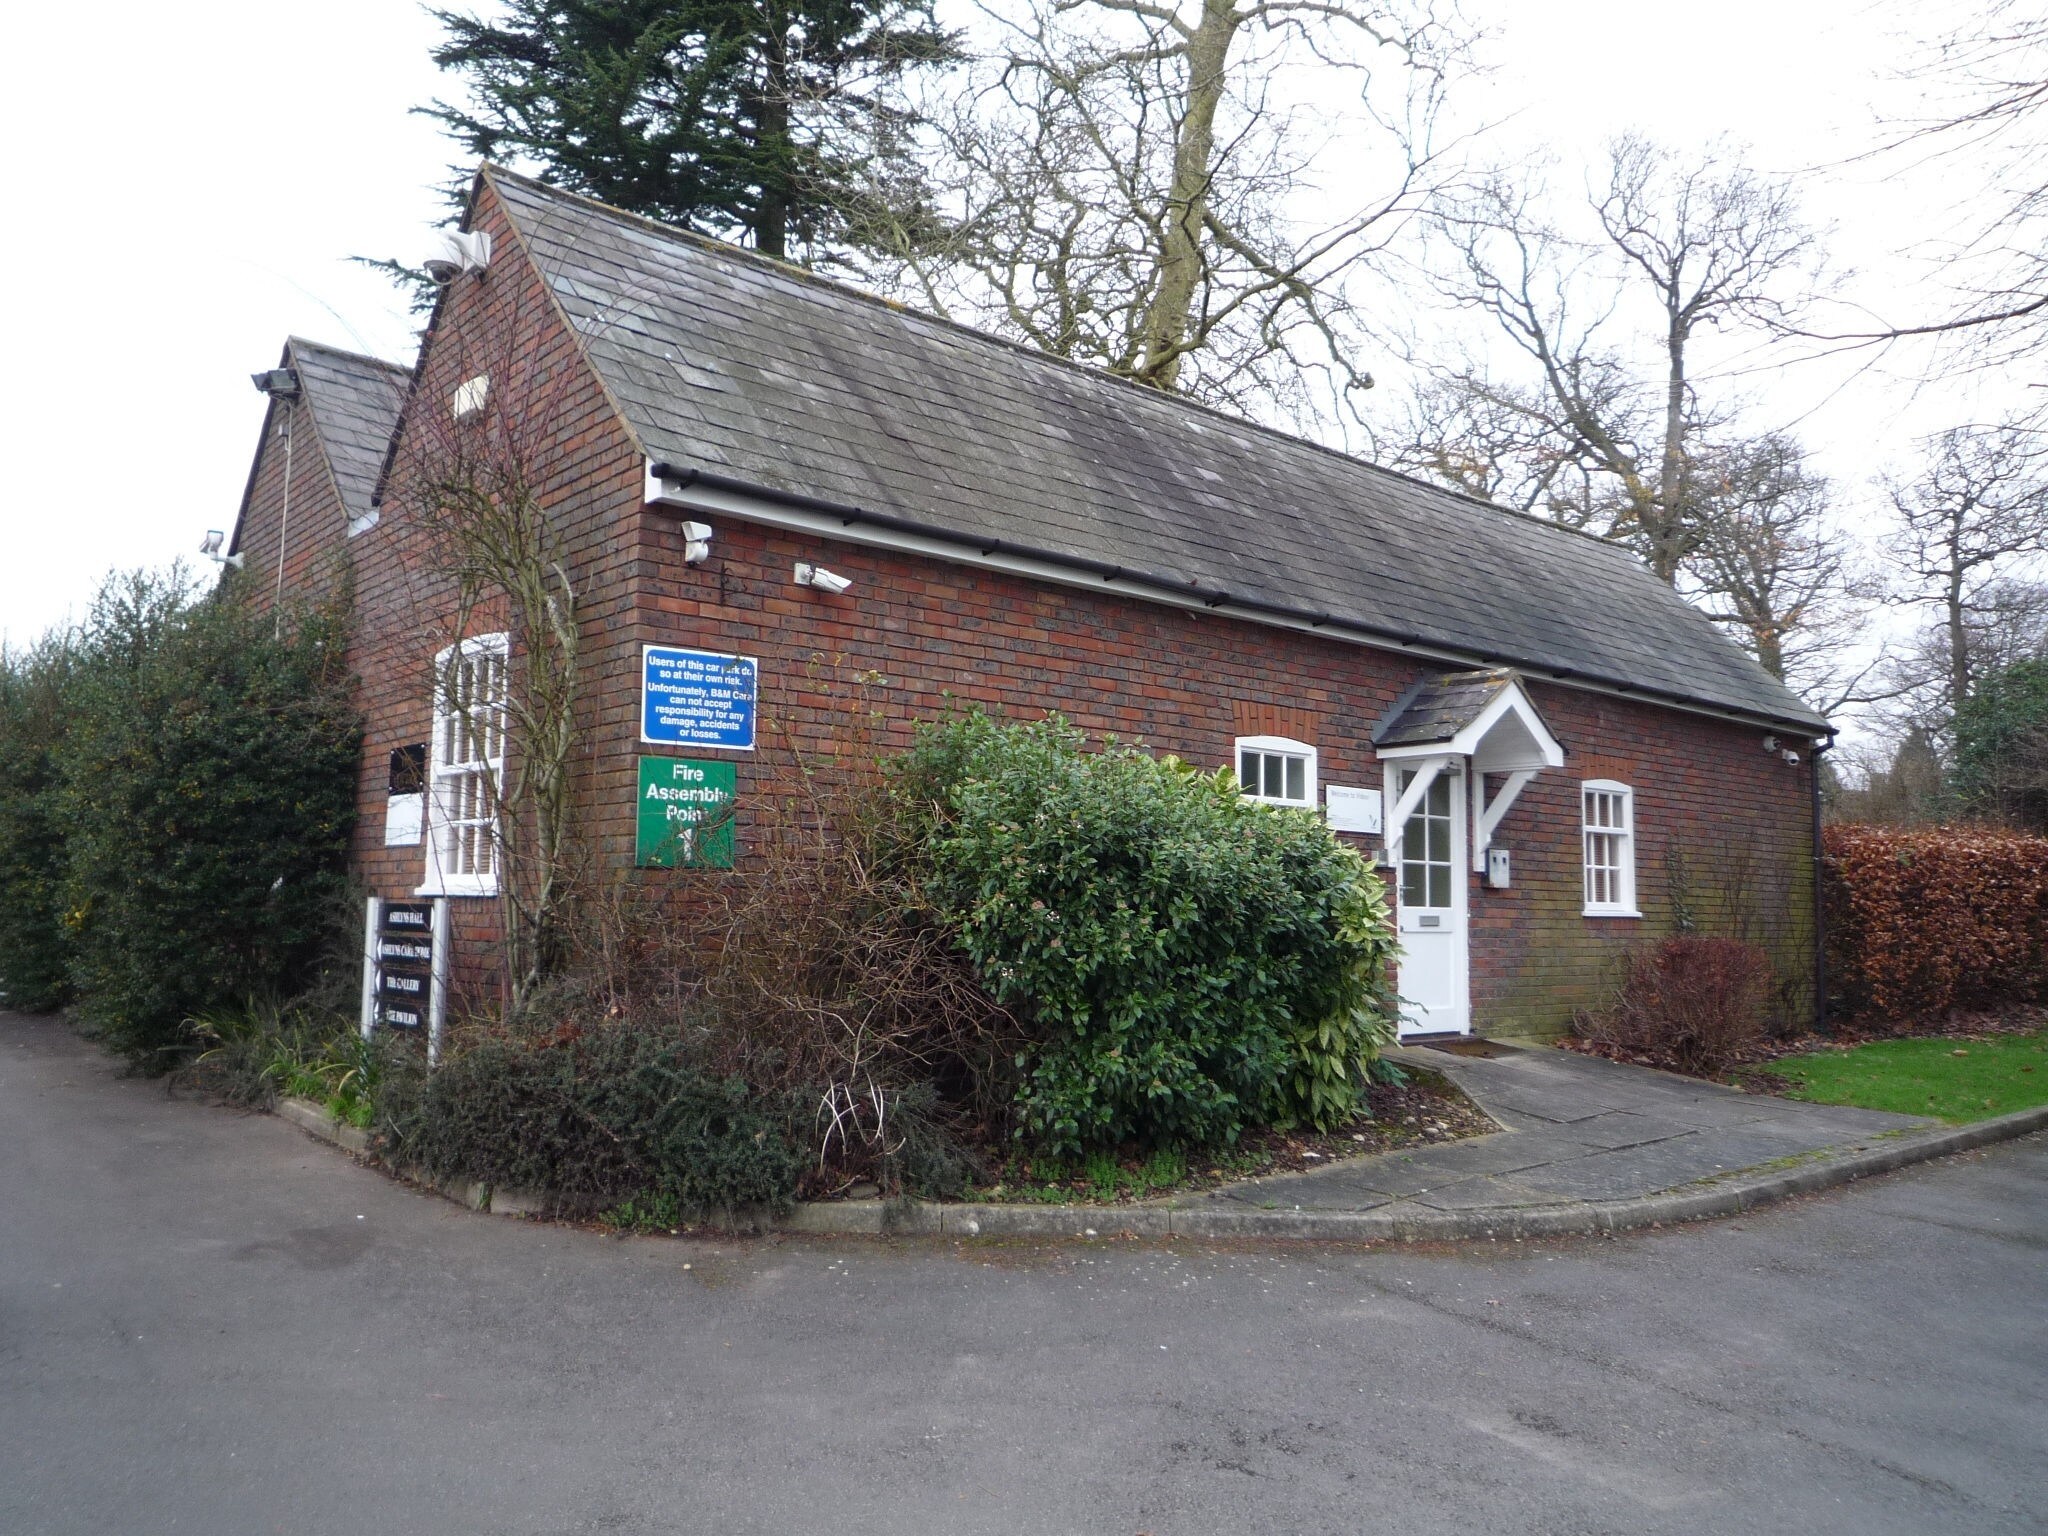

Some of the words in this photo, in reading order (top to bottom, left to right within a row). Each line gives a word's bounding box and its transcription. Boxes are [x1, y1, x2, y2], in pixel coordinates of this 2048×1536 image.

[648, 656, 675, 668] Users
[677, 660, 686, 668] of
[688, 660, 704, 670] this
[706, 664, 720, 672] car
[722, 665, 740, 675] rk
[660, 670, 671, 678] so
[674, 670, 682, 680] at
[684, 670, 704, 682] their
[706, 675, 723, 684] own
[725, 676, 742, 686] risk.
[648, 682, 708, 697] Unfortunately,
[711, 688, 730, 698] B&M
[670, 696, 686, 704] can
[688, 697, 702, 706] not
[704, 700, 732, 710] accept
[656, 705, 714, 719] responsibility
[716, 709, 728, 719] for
[729, 712, 744, 722] any
[660, 716, 698, 728] damage,
[700, 720, 740, 731] accidents
[680, 728, 690, 737] or
[691, 728, 722, 740] losses.
[673, 764, 704, 782] Fire
[646, 783, 729, 804] Assembly
